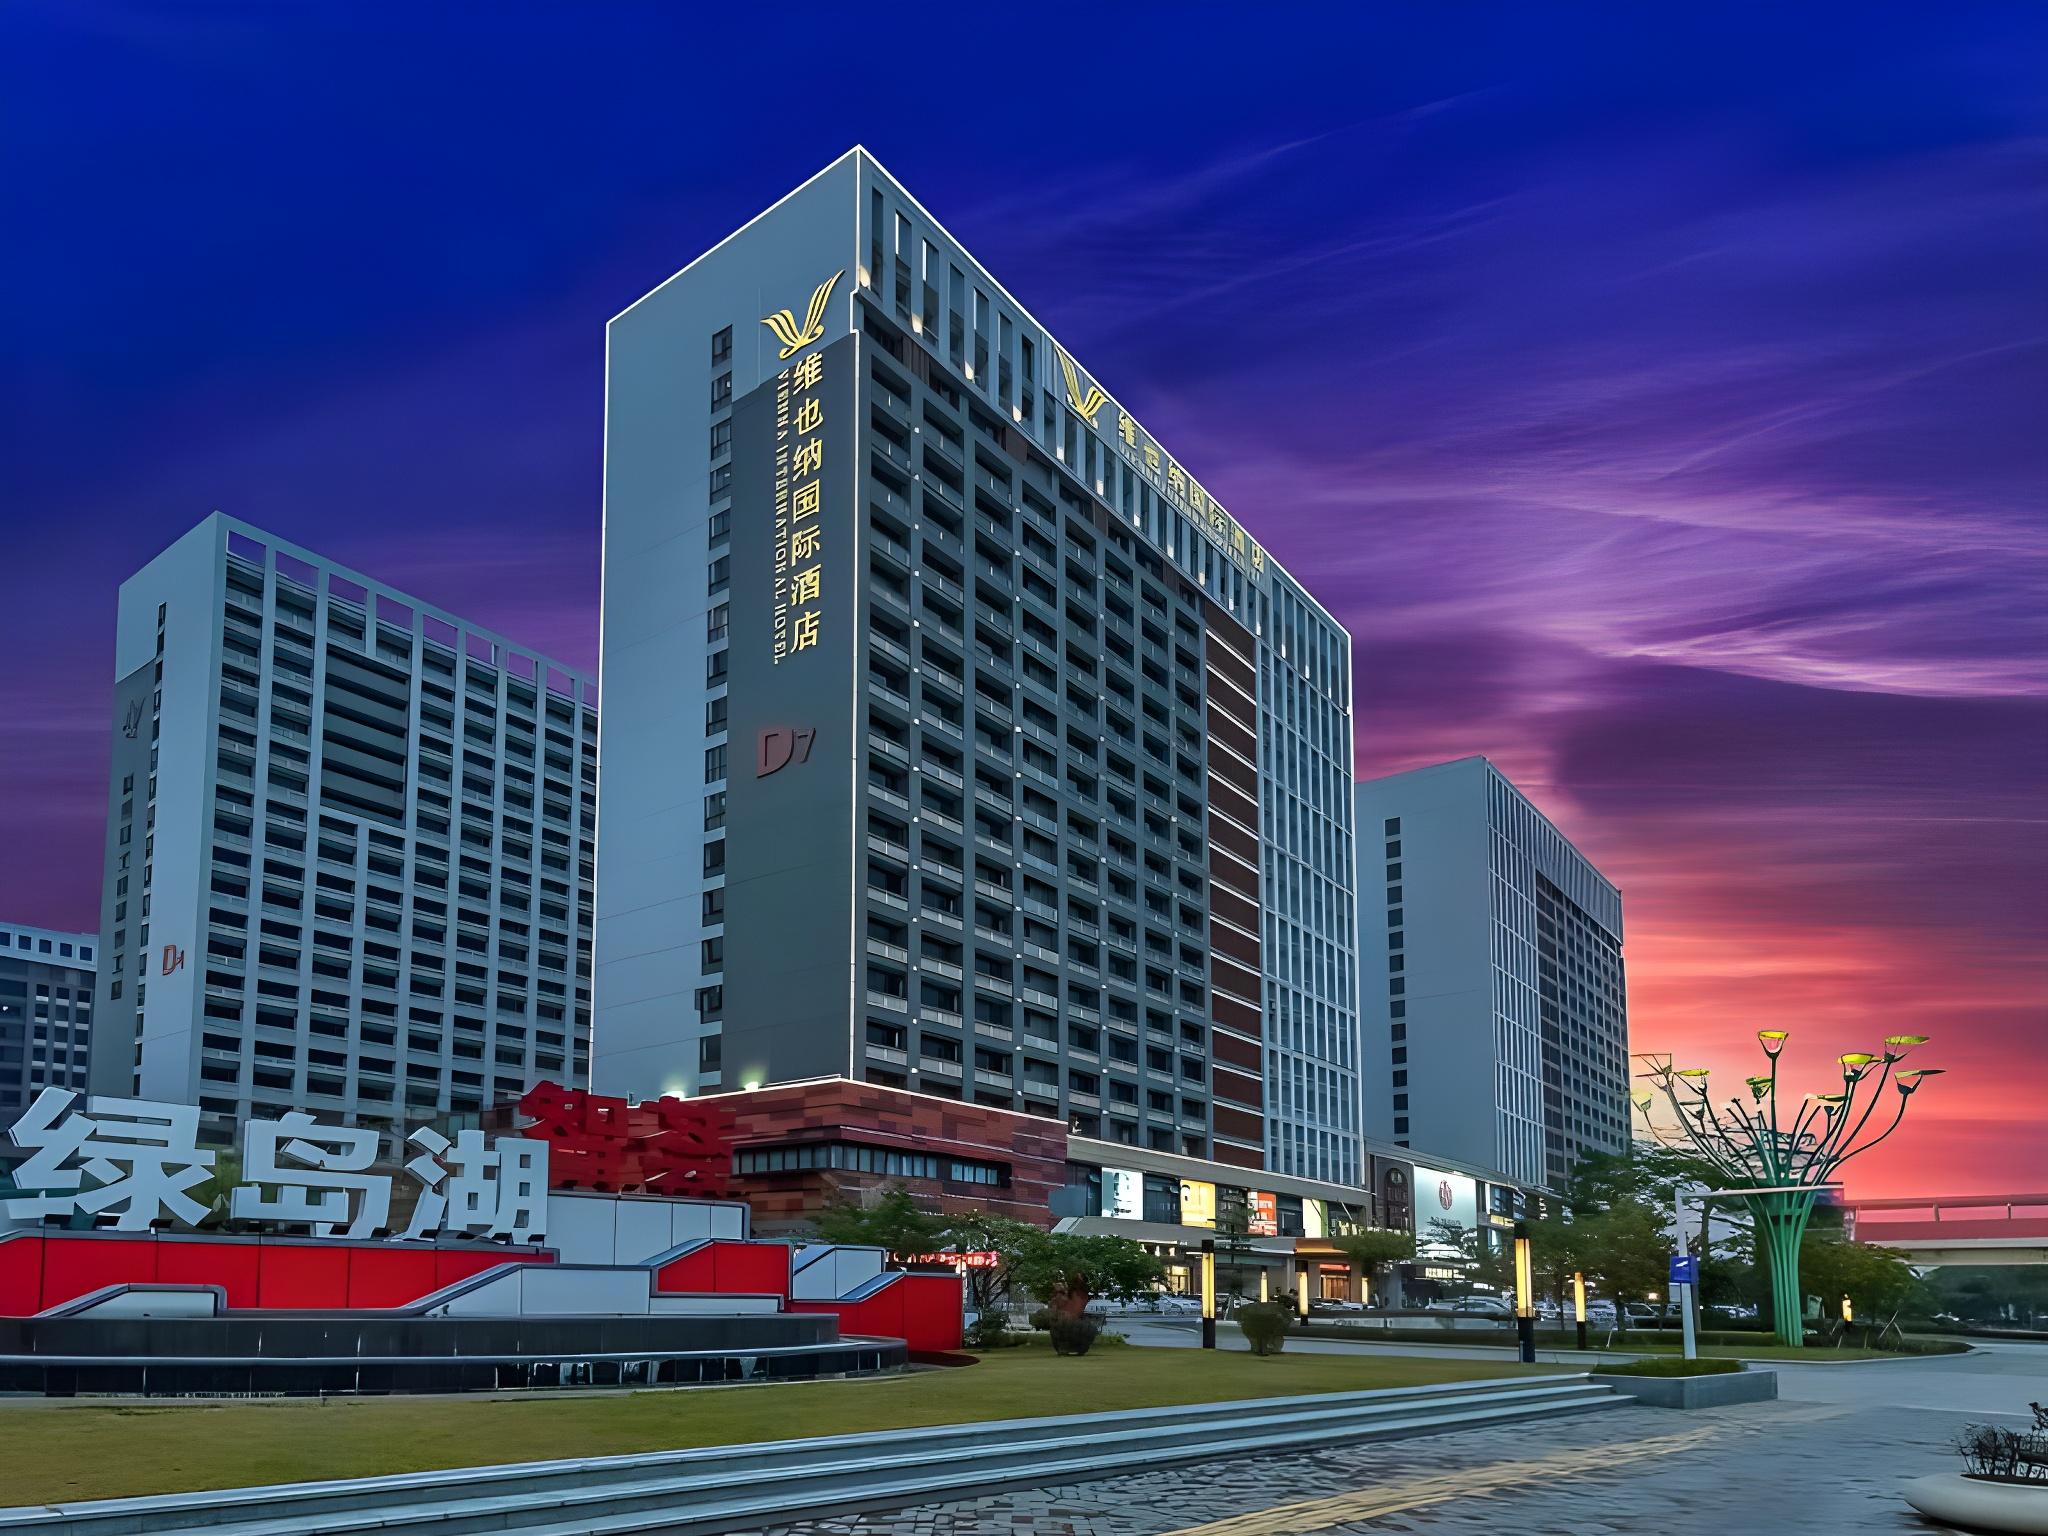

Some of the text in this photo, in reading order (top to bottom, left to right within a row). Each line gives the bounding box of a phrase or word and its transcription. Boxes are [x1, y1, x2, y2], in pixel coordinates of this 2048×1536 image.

[789, 352, 824, 653] 维也纳国际酒店
[756, 727, 817, 779] D7
[7, 1086, 550, 1243] 绿岛湖
